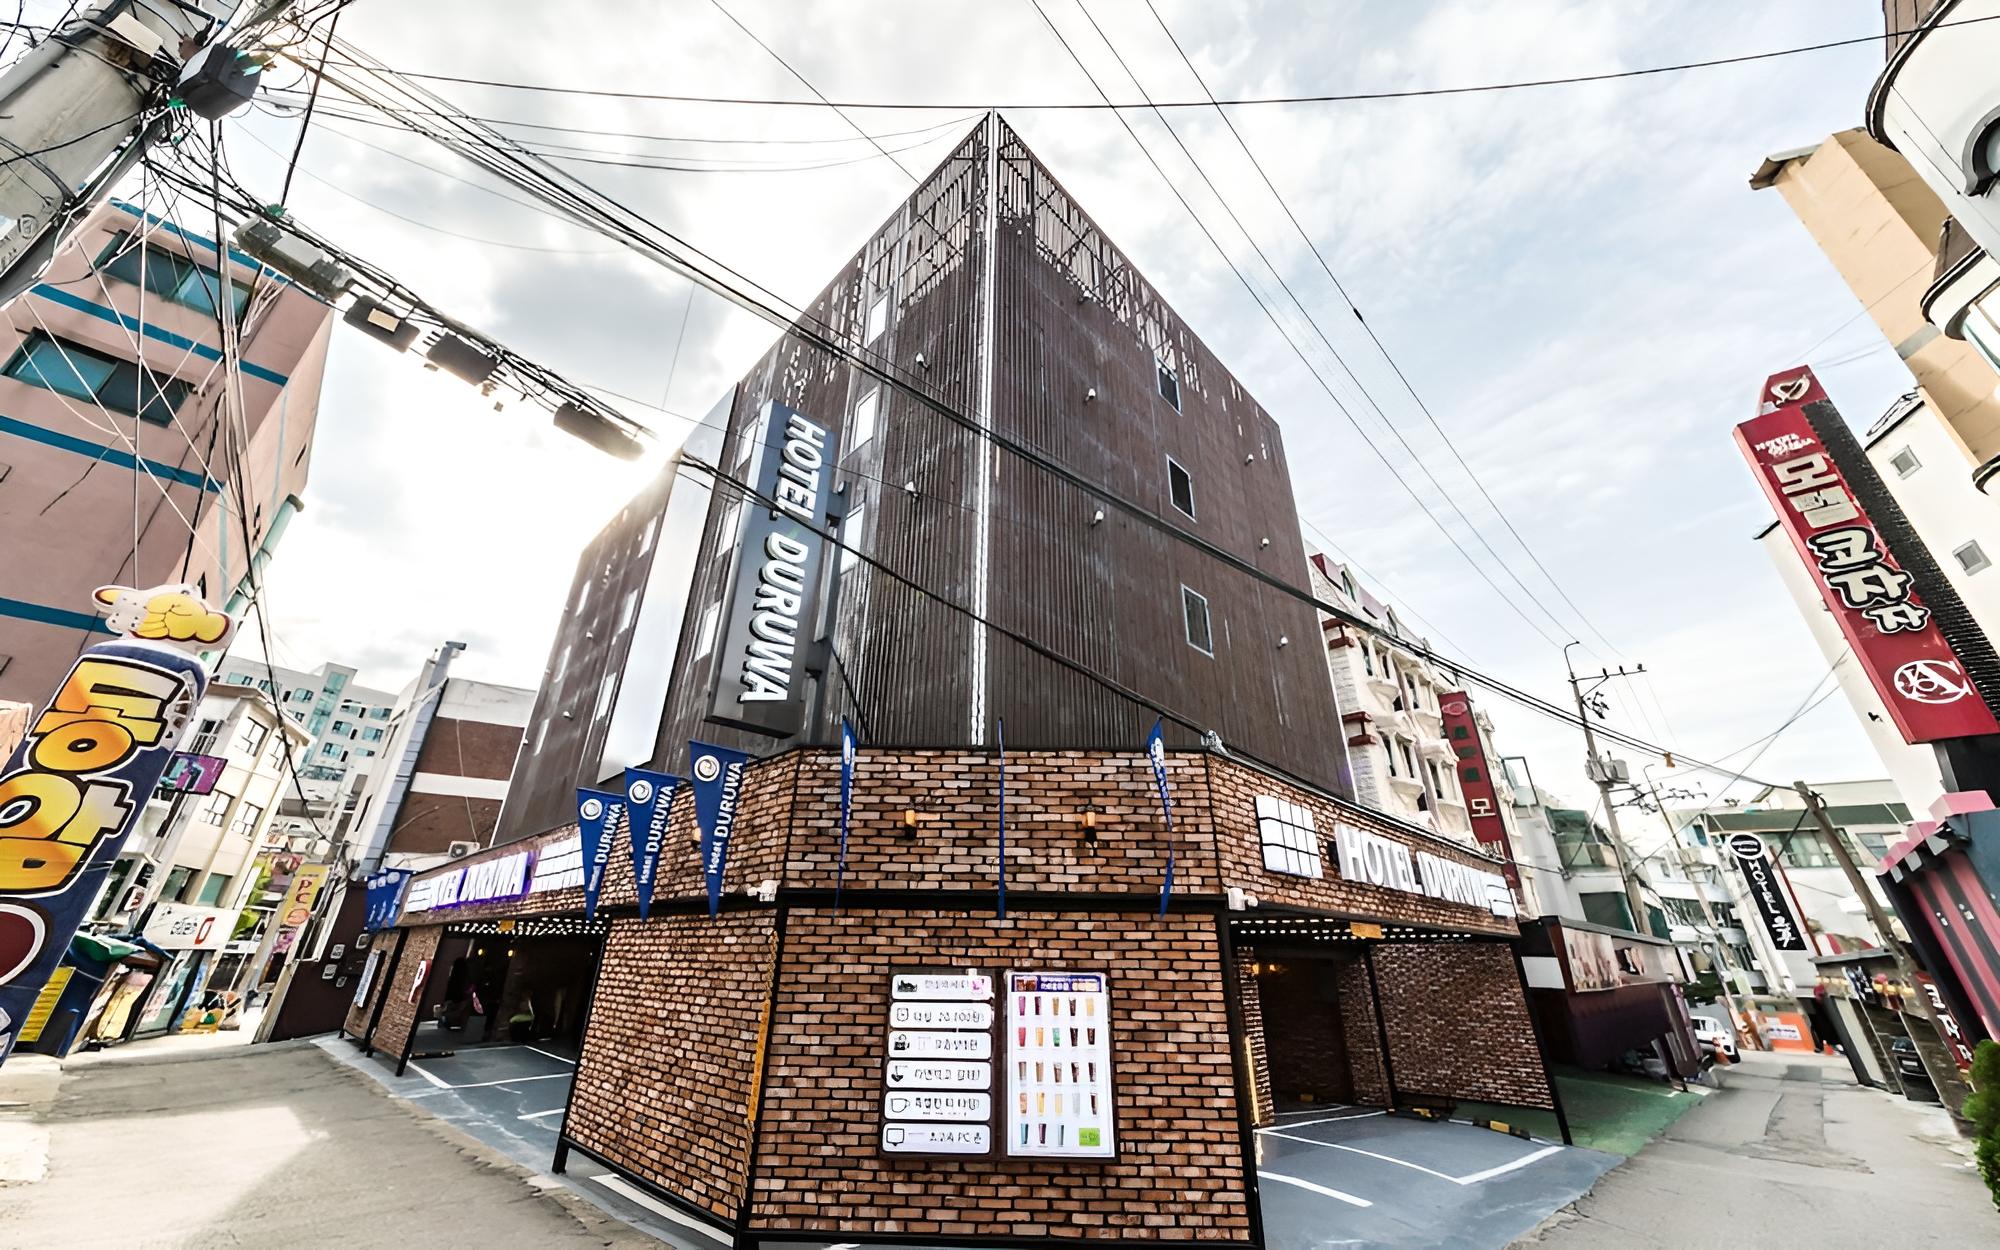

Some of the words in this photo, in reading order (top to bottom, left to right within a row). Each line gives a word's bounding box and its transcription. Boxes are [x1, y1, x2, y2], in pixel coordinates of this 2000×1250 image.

[774, 413, 826, 521] HOTEL
[741, 531, 809, 702] DURUWA
[1808, 527, 1931, 634] 코자자
[593, 803, 623, 864] DURUWA
[645, 785, 676, 853] DURUWA
[713, 761, 744, 839] DURUWA
[1334, 822, 1425, 896] HOTEL
